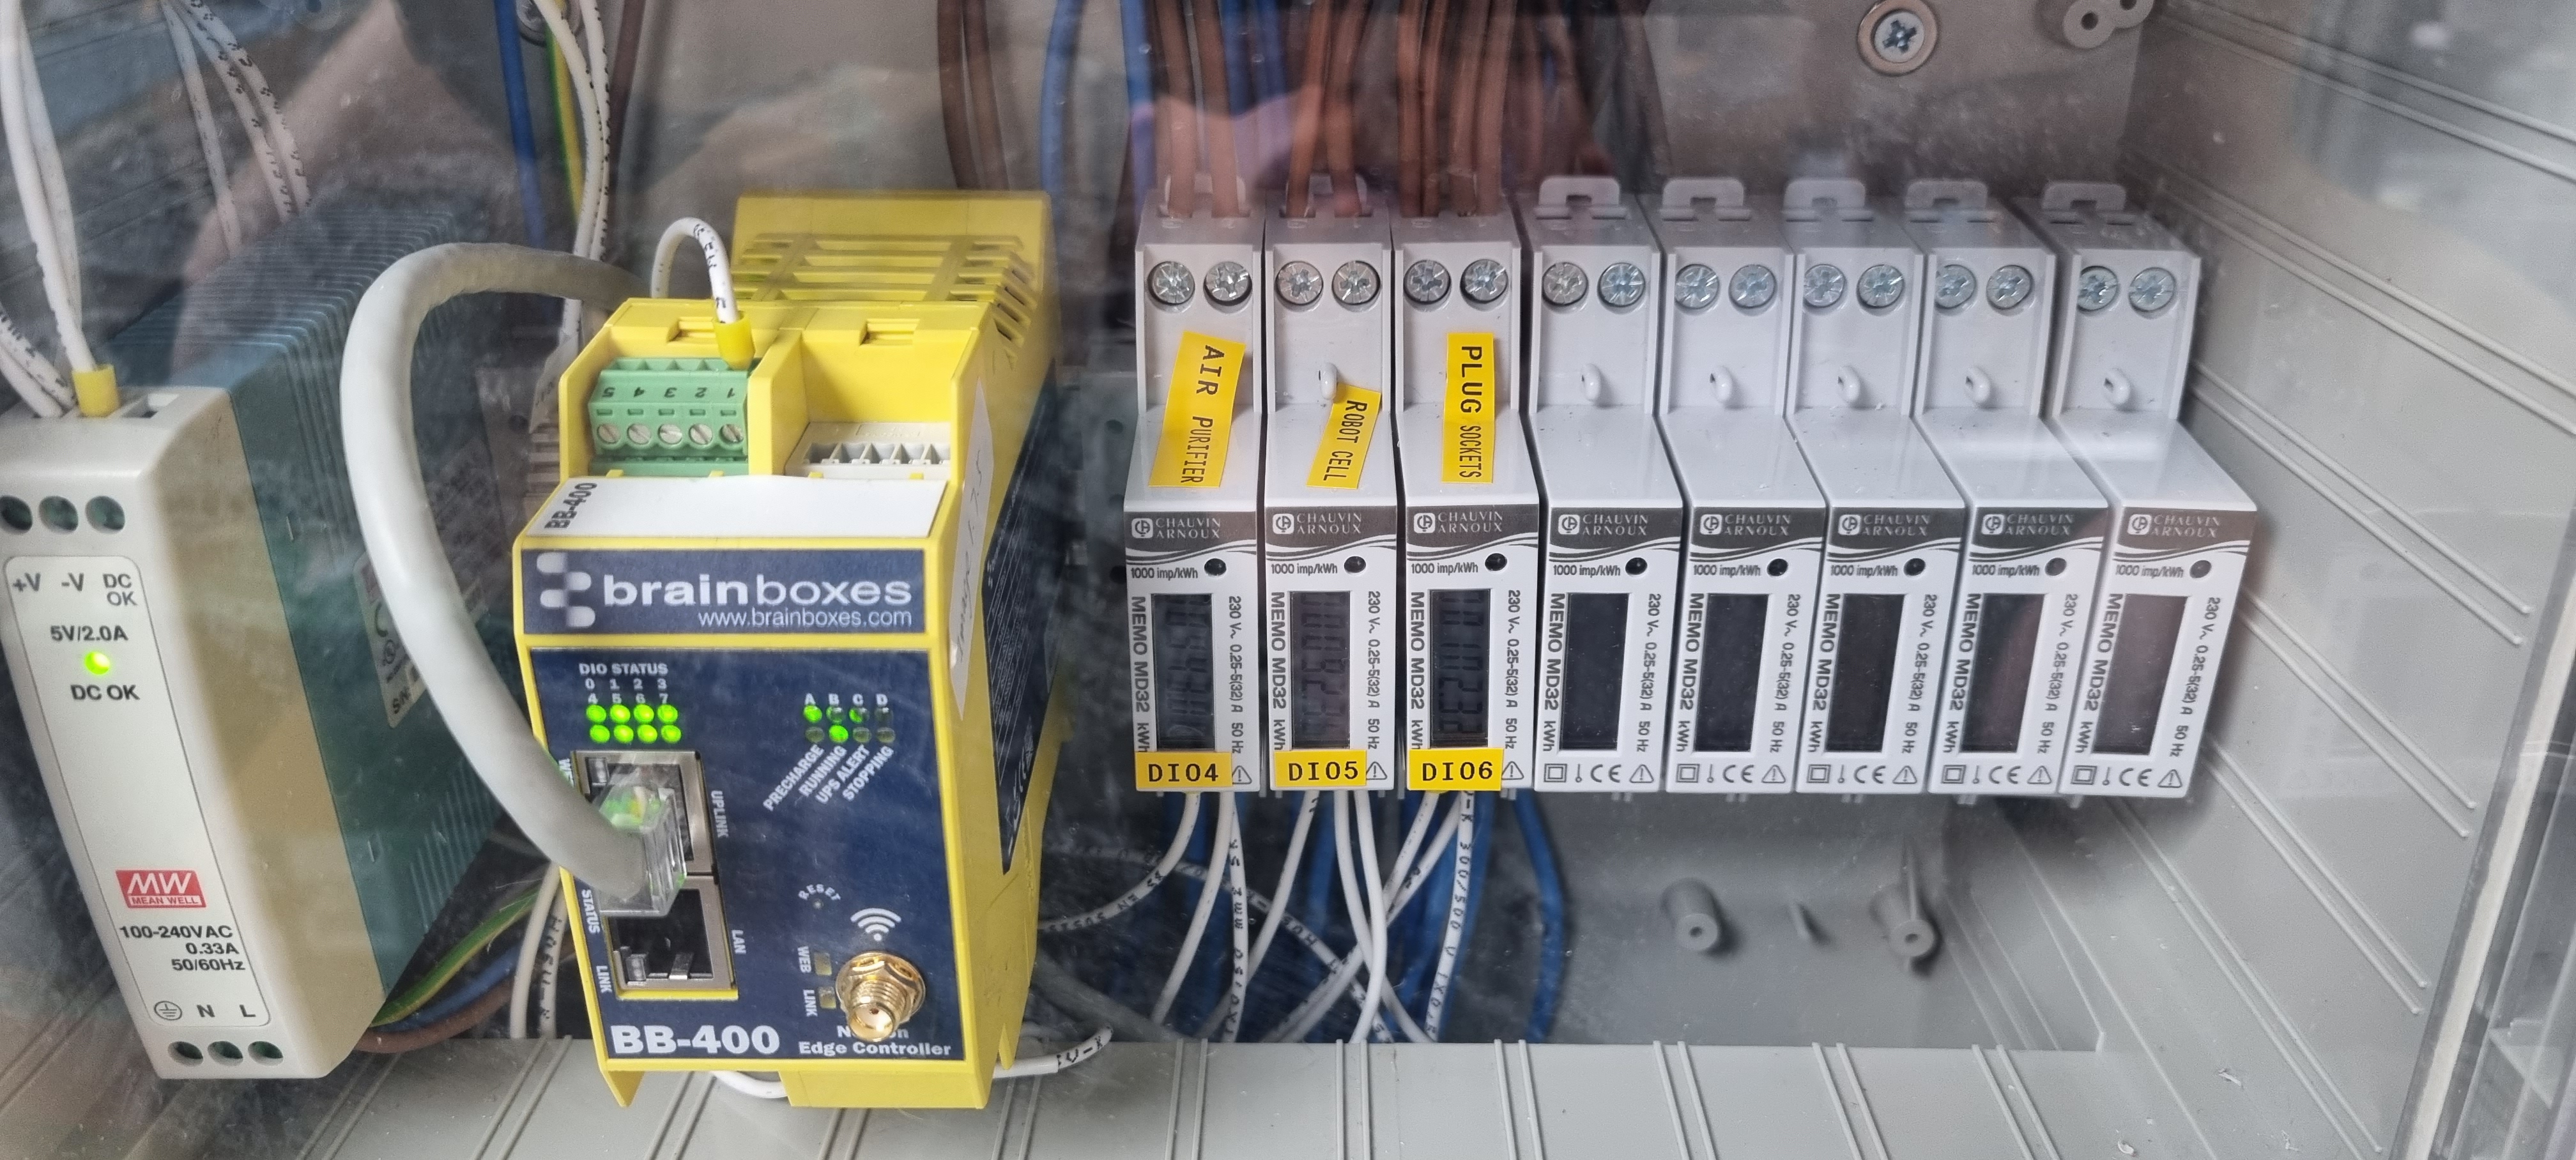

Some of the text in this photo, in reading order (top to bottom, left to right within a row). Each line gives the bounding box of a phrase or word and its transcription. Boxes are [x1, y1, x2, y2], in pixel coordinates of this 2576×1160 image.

[602, 386, 736, 399] 1 2 3 4 5
[1179, 344, 1225, 484] AIR PURIFIER
[1459, 346, 1483, 479] PLUG SOCKETS
[1322, 400, 1368, 482] ROBOT CELL
[544, 482, 597, 530] BB-400
[1156, 518, 1220, 527] CHAUVIN
[1297, 514, 1361, 523] CHAUVIN
[1438, 512, 1503, 521] CHAUVIN
[1583, 515, 1648, 524] CHAUVIN
[1726, 515, 1790, 524] CHAUVIN
[1864, 515, 1928, 524] CHAUVIN
[2007, 515, 2074, 523] CHAUVIN
[1158, 530, 1220, 538] ARNOUX
[1298, 524, 1361, 534] ARNOUX
[1439, 523, 1501, 533] ARNOUX
[1584, 526, 1647, 535] ARNOUX
[1725, 526, 1788, 535] ARNOUX
[1862, 526, 1927, 535] ARNOUX
[2006, 526, 2070, 535] ARNOUX
[1131, 568, 1198, 581] 1000 imp/kWh
[1271, 563, 1337, 576] 1000 imp/kWh
[1412, 562, 1478, 576] 1000 imp/kWh
[1554, 565, 1620, 577] 1000 imp/kWh
[1694, 565, 1760, 577] 1000 imp/kWh
[1831, 565, 1854, 576] 1000
[1973, 565, 1995, 576] 1000
[13, 573, 131, 591] +V -V DC
[604, 574, 911, 606] brainboxes
[107, 591, 137, 606] OK
[1368, 591, 1380, 613] 230
[1508, 590, 1521, 613] 230
[1648, 594, 1661, 616] 230
[1787, 594, 1800, 616] 230
[1923, 595, 1937, 616] 230
[2064, 594, 2078, 616] 230
[1229, 596, 1241, 618] 230
[698, 607, 911, 625] www.brainboxes.com
[2099, 594, 2123, 653] MEMO
[50, 625, 128, 641] 5V/2.0A
[579, 664, 668, 675] DIO STATUS
[1132, 597, 1149, 752] MEMO MD32 kWh
[1271, 592, 1285, 750] MEMO MD32 kWh
[1411, 592, 1424, 749] MEMO MD32 kWh
[1544, 593, 1565, 751] MEMO MD32 kWh
[1676, 593, 1704, 751] MEMO MD32 kWh
[1809, 594, 1840, 752] MEMO MD32 kWh
[1943, 593, 1981, 752] MEMO MD32 kWh
[585, 678, 666, 689] 0 1 2 3
[2084, 660, 2108, 712] MD32
[71, 685, 140, 700] DC OK
[588, 692, 668, 704] 4 5 6 7
[804, 693, 887, 705] A B C D
[1232, 723, 1243, 736] 50
[1368, 719, 1379, 733] 50
[1506, 719, 1517, 732] 50
[1639, 721, 1650, 735] 50
[1772, 721, 1784, 735] 50
[1232, 741, 1243, 753] Hz
[1368, 736, 1379, 749] Hz
[1505, 736, 1517, 749] Hz
[1637, 740, 1648, 752] Hz
[1770, 740, 1782, 752] Hz
[762, 744, 825, 811] PRECHARGE
[798, 745, 847, 798] RUNNING
[816, 744, 870, 804] UPS ALERT
[842, 745, 894, 802] STOPPING
[711, 791, 728, 837] UPLINK
[127, 873, 192, 894] MW
[799, 884, 841, 900] RESET
[582, 890, 600, 933] STATUS
[120, 926, 233, 938] 100-240VAC
[186, 943, 239, 954] 0.33A
[732, 930, 746, 953] LAN
[171, 959, 245, 971] 50/60Hz
[798, 946, 811, 972] WEB
[597, 966, 612, 993] LINK
[804, 990, 817, 1016] LINK
[197, 1005, 256, 1017] N L
[611, 1025, 779, 1053] BB-400
[799, 1042, 951, 1056] Edge Controller
